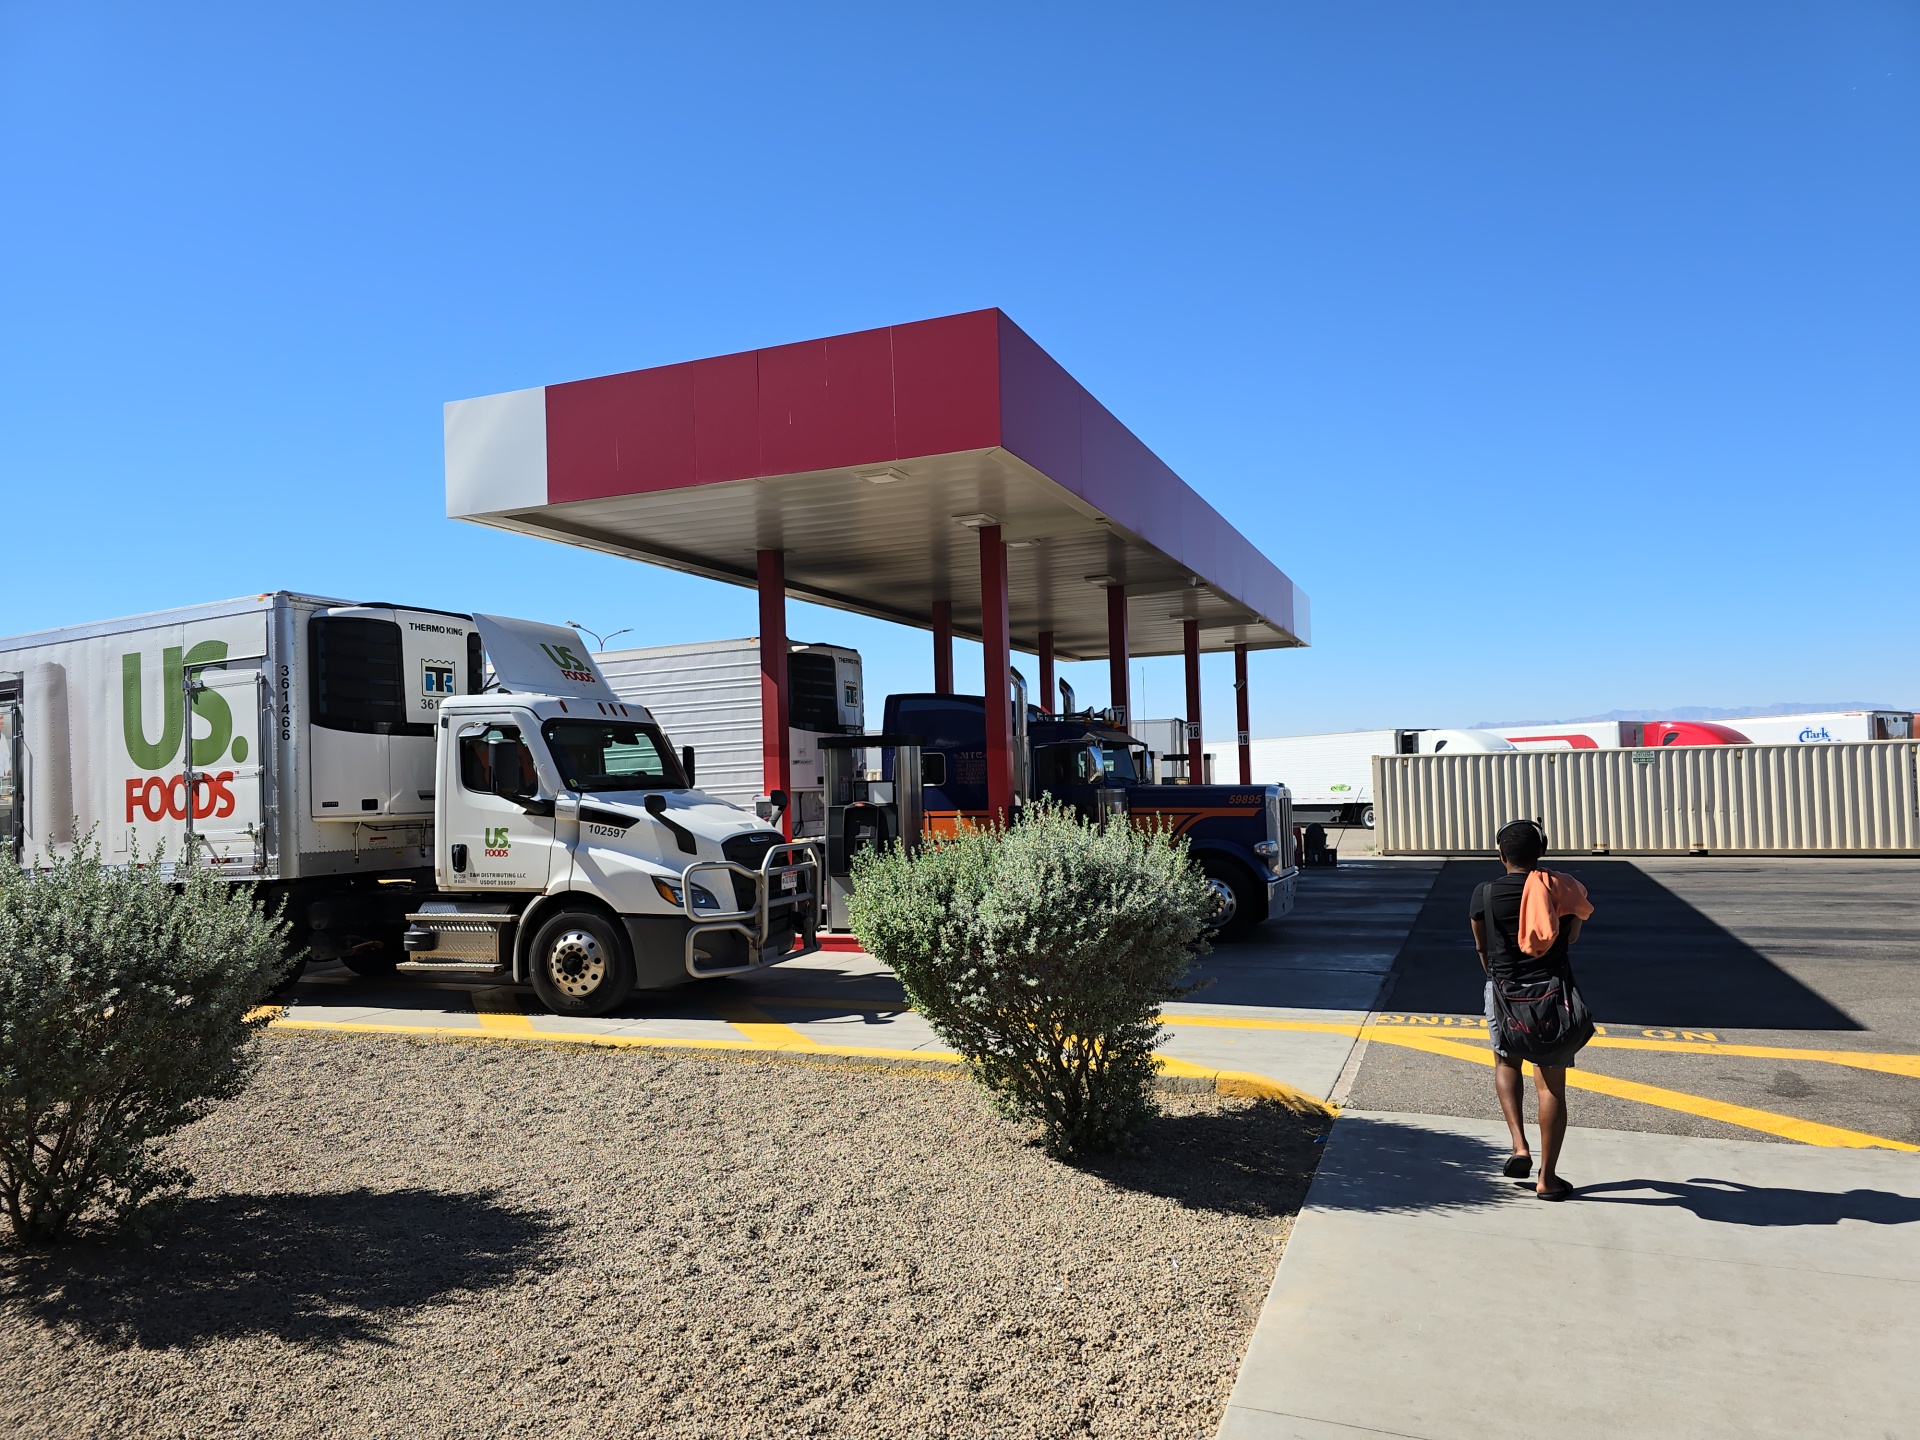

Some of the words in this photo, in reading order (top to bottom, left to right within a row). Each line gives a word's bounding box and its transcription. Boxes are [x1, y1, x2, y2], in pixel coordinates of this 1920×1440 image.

[409, 622, 445, 634] THERMO
[446, 626, 463, 636] KING
[561, 670, 595, 683] FOODS
[280, 665, 291, 741] 361466
[1189, 726, 1200, 738] 18
[1239, 734, 1249, 744] 19
[126, 770, 235, 823] FOODS
[1228, 795, 1262, 804] 59895
[588, 823, 627, 839] 102597
[485, 849, 509, 857] FOODS
[1641, 1029, 1719, 1041] NO
